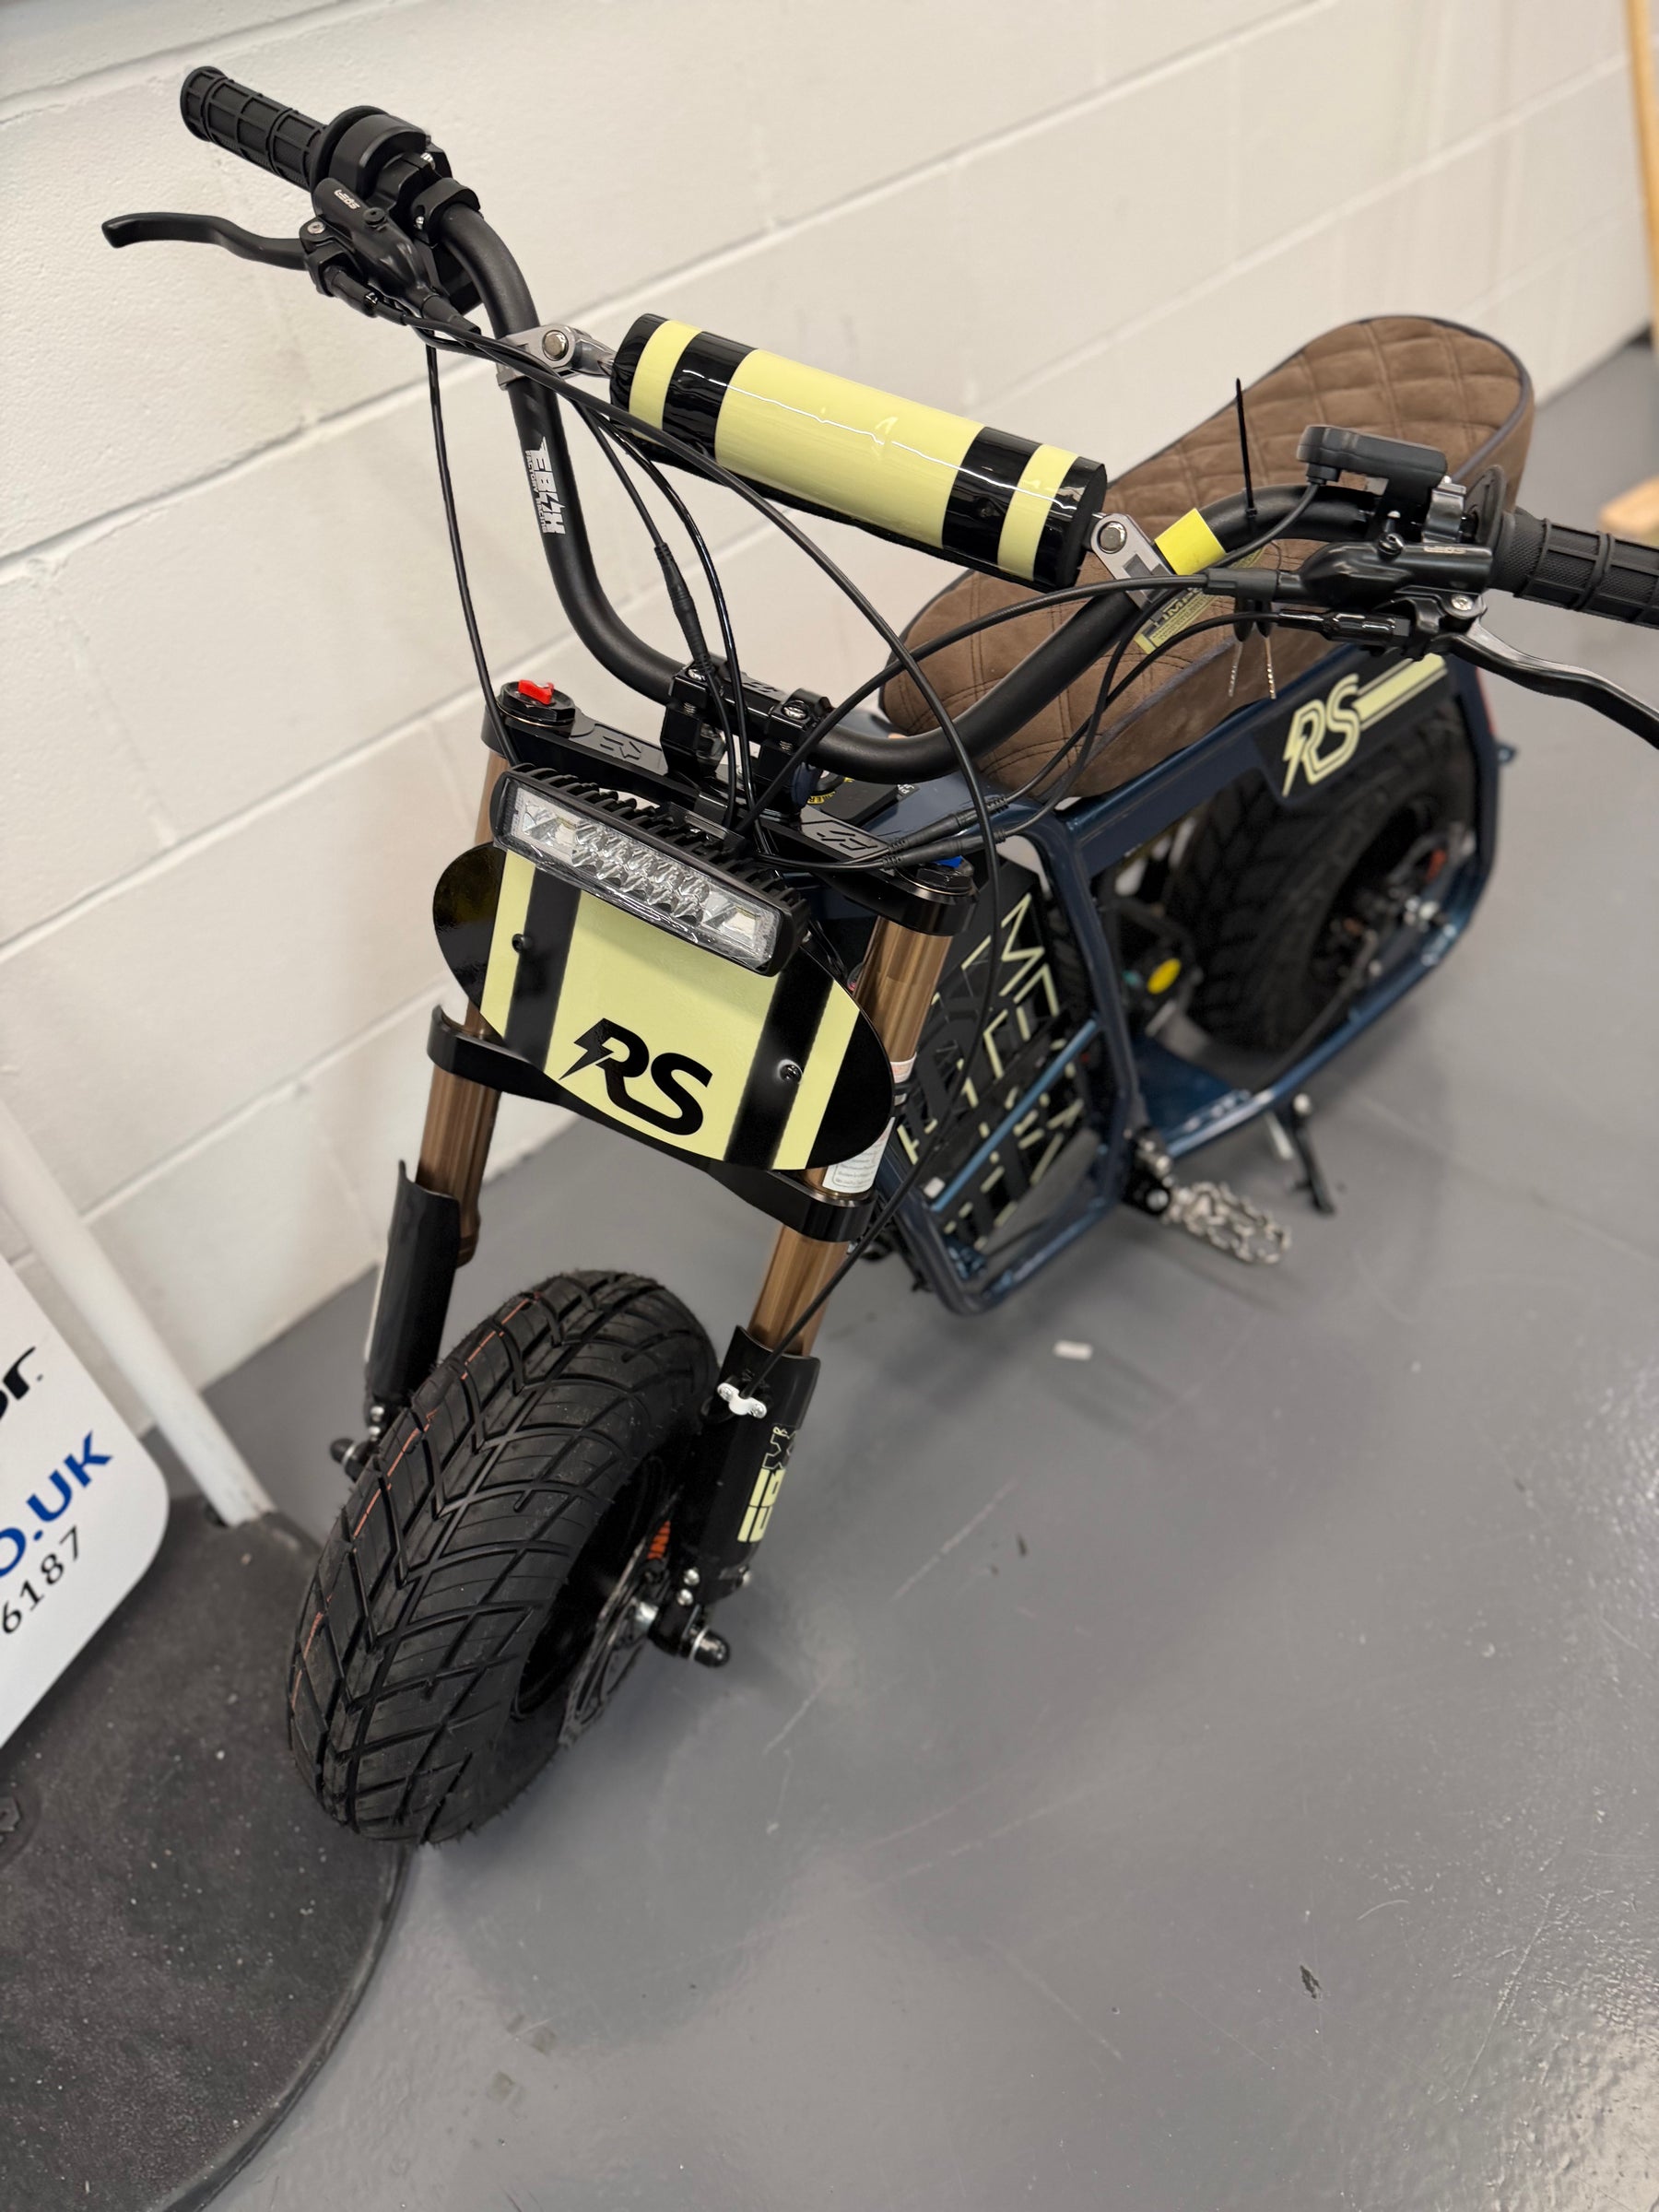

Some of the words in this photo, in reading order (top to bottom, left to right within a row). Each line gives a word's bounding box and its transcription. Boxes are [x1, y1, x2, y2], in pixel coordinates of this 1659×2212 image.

[1282, 673, 1360, 798] RS
[558, 1017, 714, 1136] RS
[1, 1524, 78, 1635] 6187
